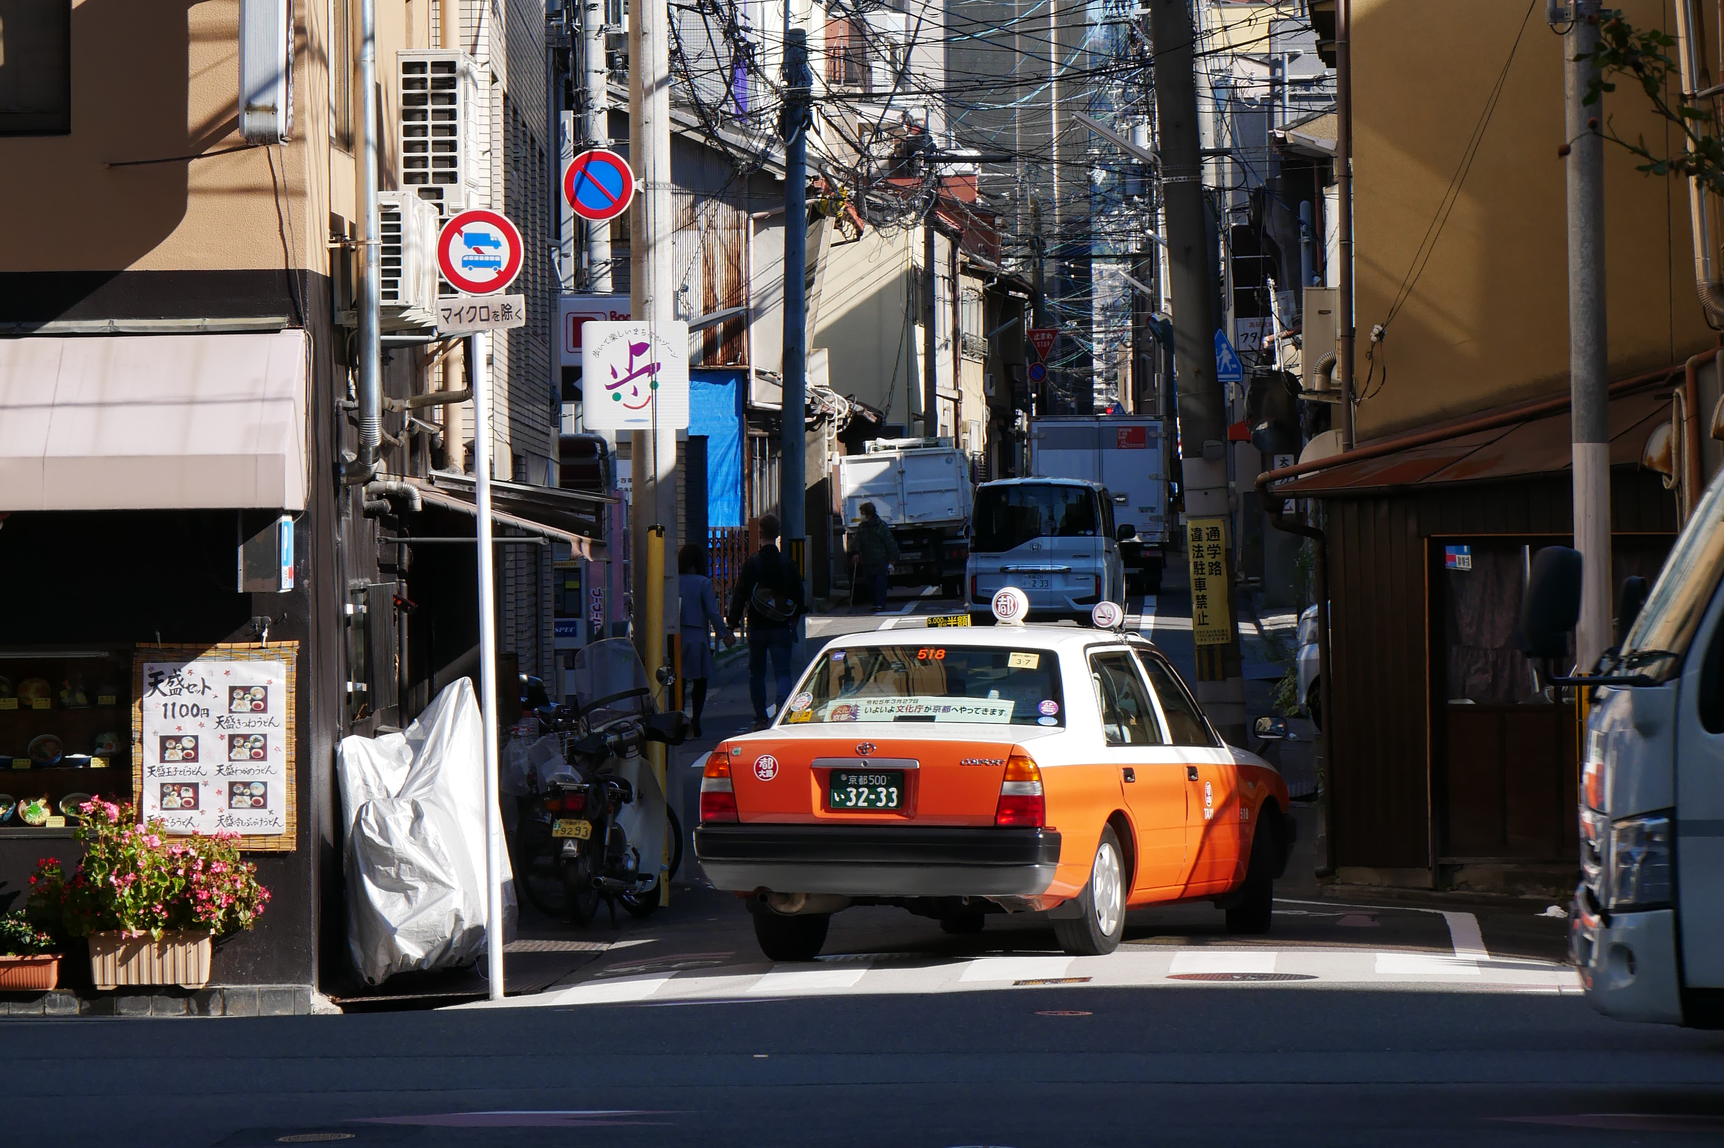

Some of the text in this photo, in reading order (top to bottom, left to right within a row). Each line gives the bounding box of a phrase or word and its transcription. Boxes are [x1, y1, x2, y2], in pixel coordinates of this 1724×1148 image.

[441, 303, 522, 324] マイクロを除く
[1033, 332, 1053, 341] 止まれ
[1036, 340, 1050, 348] STOP
[1205, 526, 1222, 577] 通学路
[1190, 527, 1209, 626] 違法駐車禁止
[997, 594, 1016, 616] 都
[917, 648, 946, 660] 518
[145, 668, 212, 698] 天盛セット
[162, 702, 209, 719] 1100円
[864, 704, 1008, 717] いよいよ文化庁が京都へやってきます。
[213, 715, 280, 730] 天盛きつねうどん
[214, 763, 277, 777] 天盛わかめうどん
[758, 757, 774, 770] 都
[146, 764, 208, 778] 天盛玉子とじうどん
[846, 787, 898, 807] 32-33
[560, 826, 588, 837] 9293
